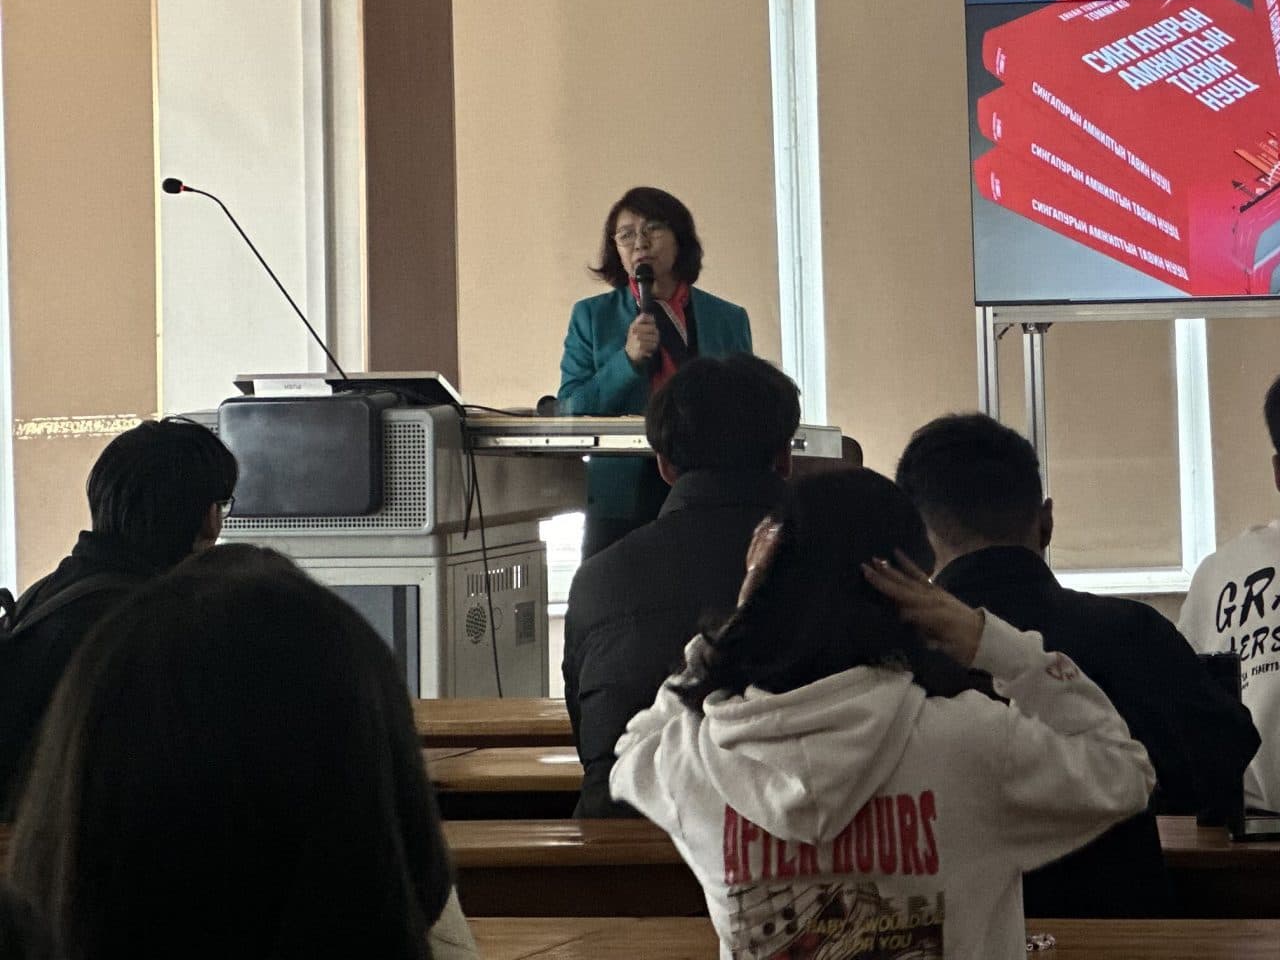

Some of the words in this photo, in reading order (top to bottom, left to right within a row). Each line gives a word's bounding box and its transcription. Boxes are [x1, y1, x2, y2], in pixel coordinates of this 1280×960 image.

[1081, 6, 1214, 73] СИНГАПУРЫН
[1117, 26, 1236, 91] АМЖИЛТЫН
[1165, 53, 1238, 94] ТАВИН
[1195, 73, 1260, 112] НУУЦ
[1032, 81, 1082, 127] СИНГАПУРЫН
[1031, 143, 1084, 184] СИНГАПУРЫН
[1031, 198, 1088, 234] СИНГАПУРЫН
